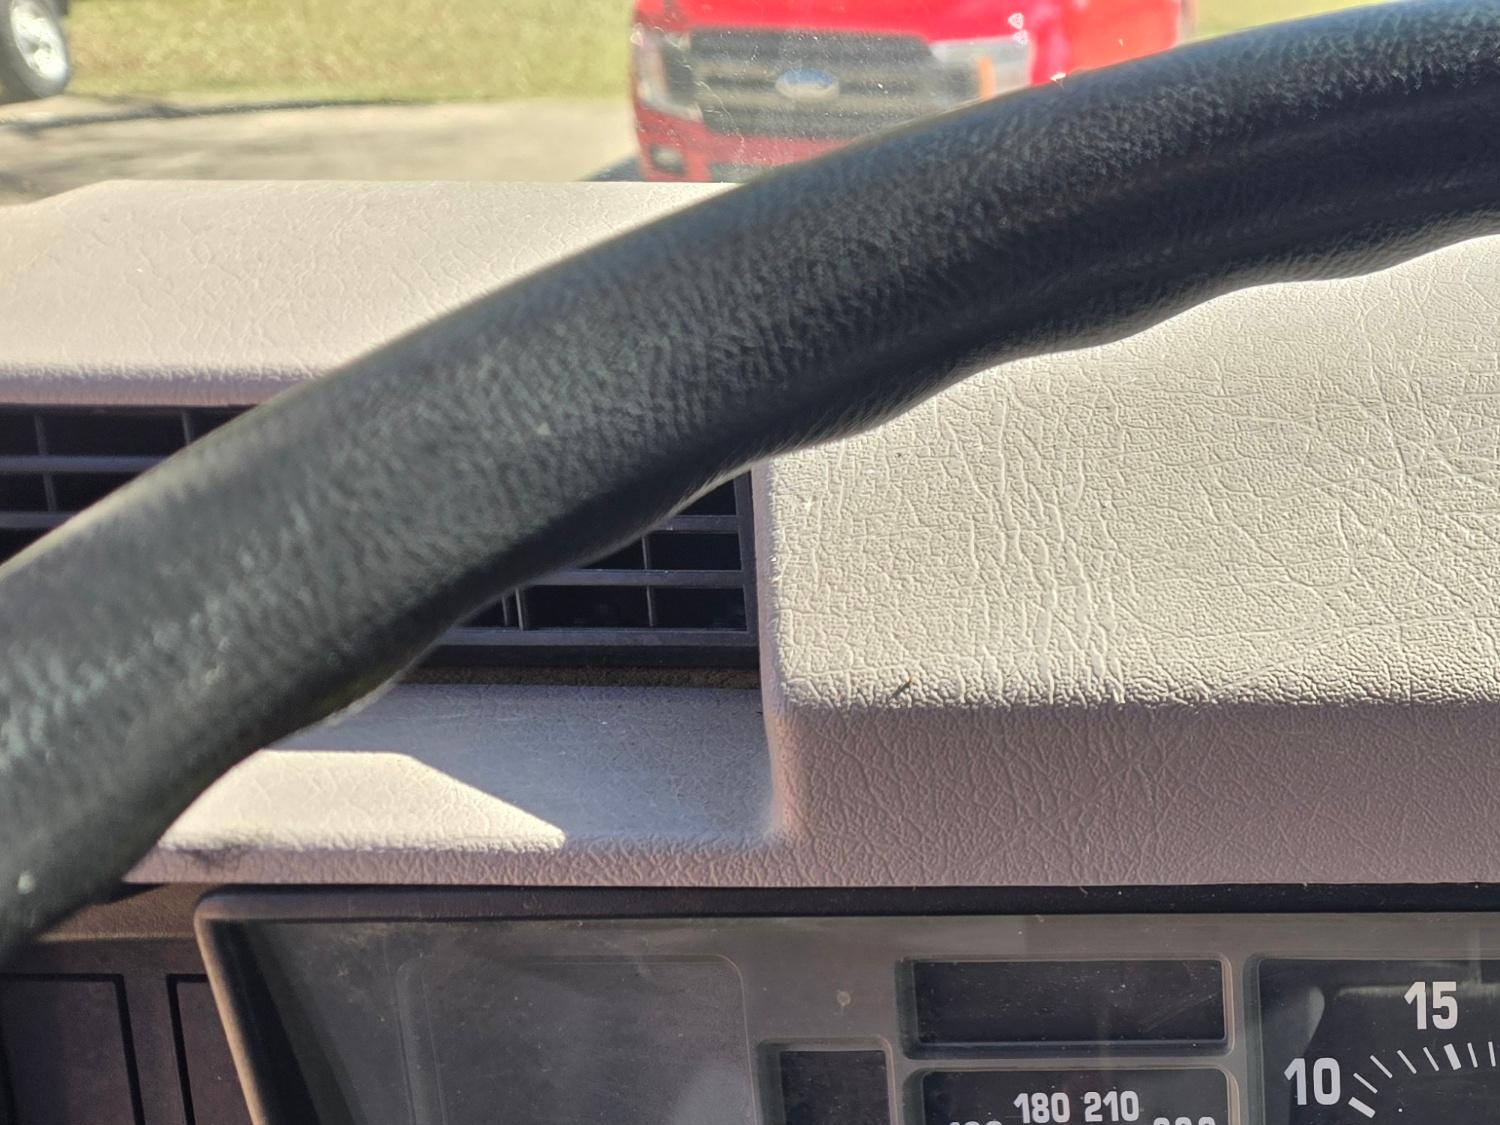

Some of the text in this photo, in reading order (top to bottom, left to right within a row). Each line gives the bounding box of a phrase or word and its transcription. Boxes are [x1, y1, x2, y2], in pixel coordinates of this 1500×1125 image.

[1404, 981, 1458, 1030] 15
[1284, 1057, 1341, 1106] 10
[1013, 1092, 1070, 1123] 180
[1084, 1091, 1139, 1122] 210
